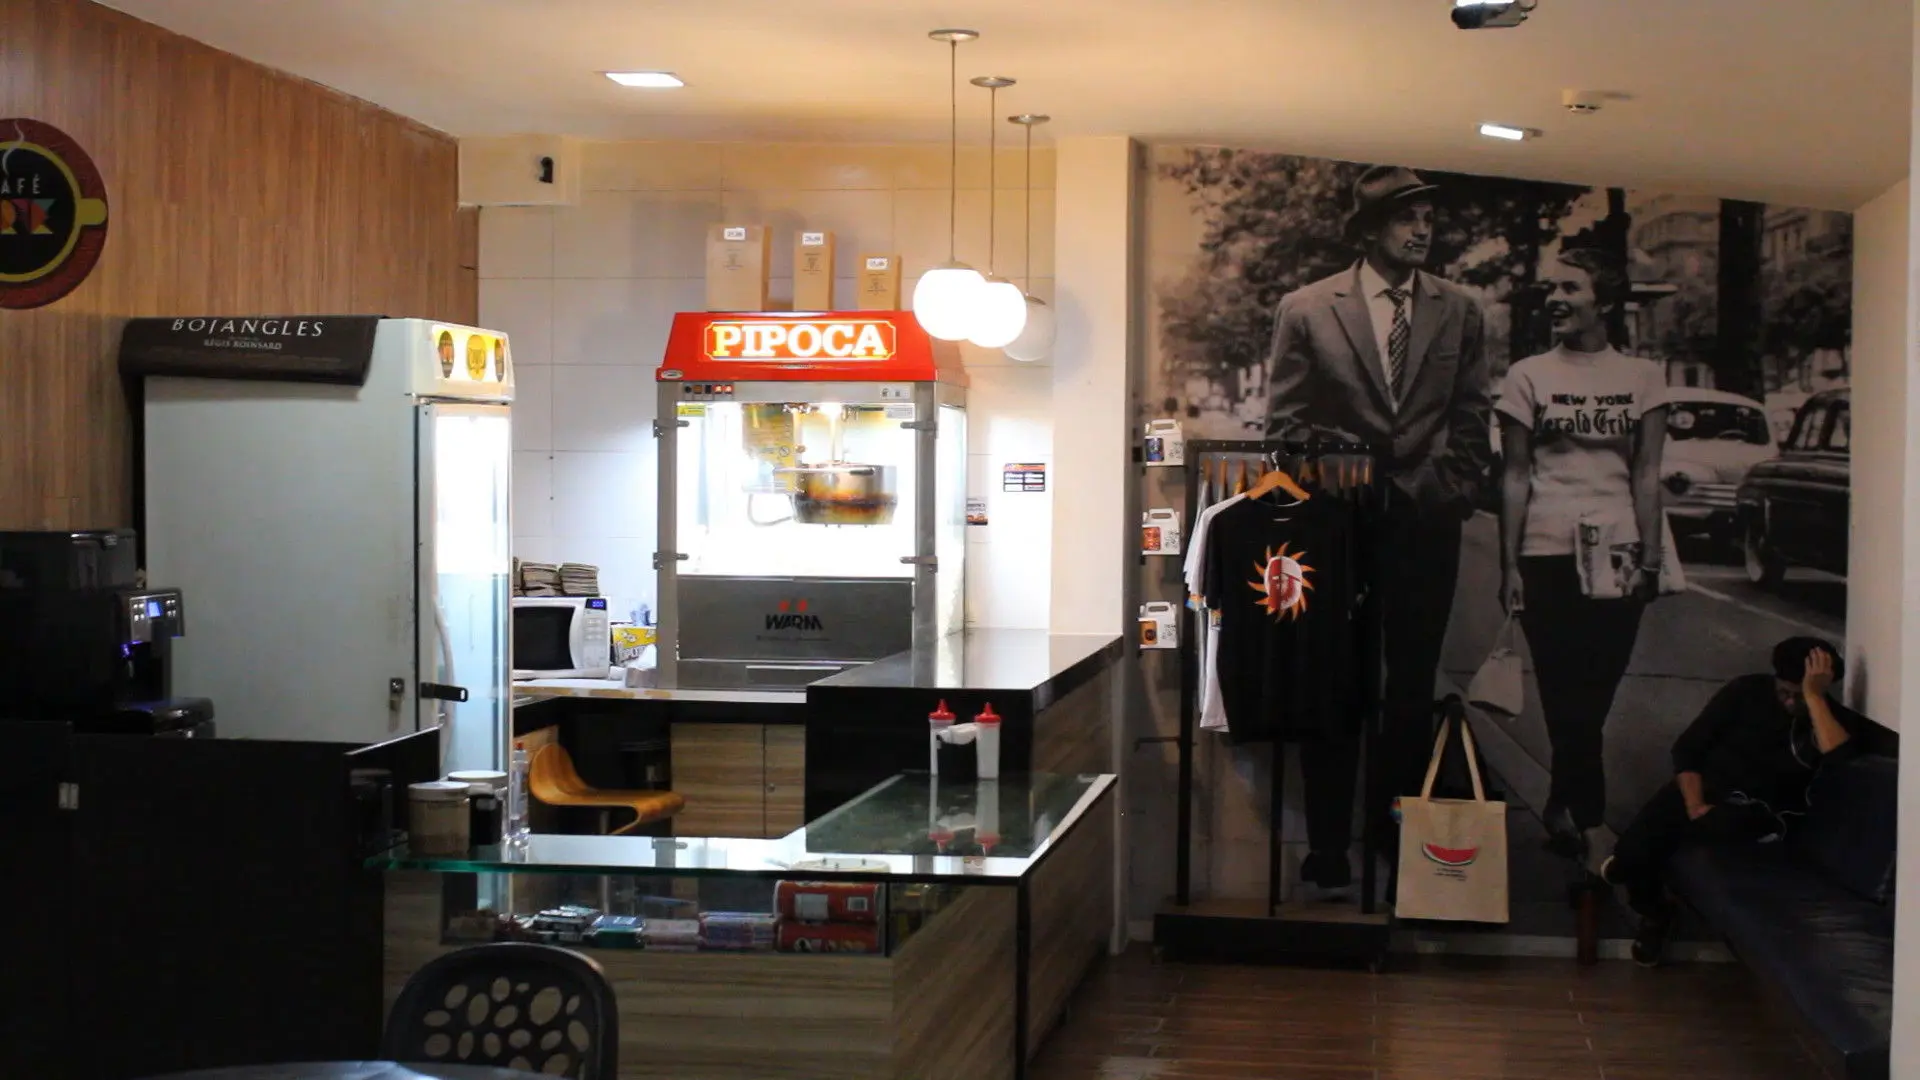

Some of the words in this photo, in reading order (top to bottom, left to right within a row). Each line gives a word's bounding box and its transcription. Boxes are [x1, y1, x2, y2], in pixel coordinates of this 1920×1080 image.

[171, 318, 328, 337] BOJANGLES
[711, 324, 889, 358] PIPOCA
[1551, 393, 1588, 406] NEW
[1593, 392, 1635, 406] YORK
[765, 613, 824, 631] WARM
